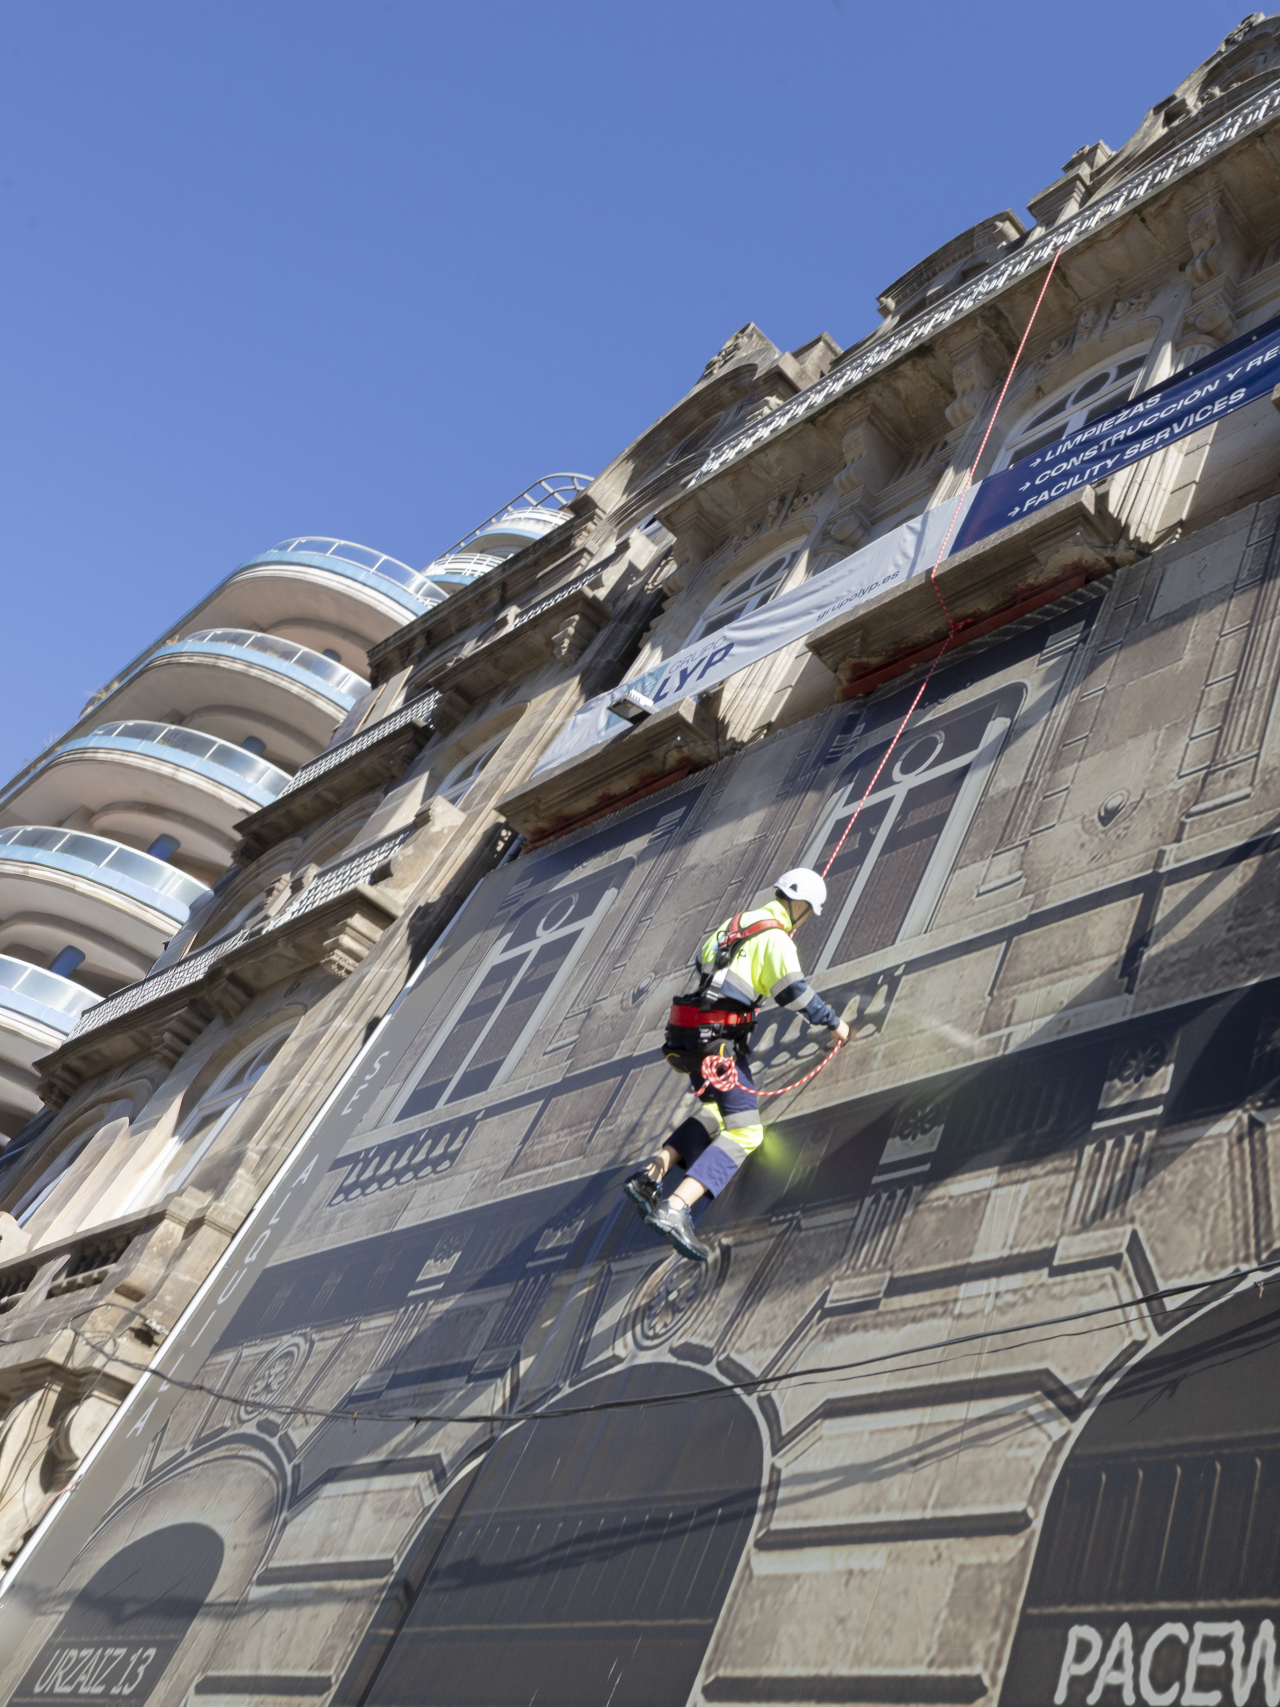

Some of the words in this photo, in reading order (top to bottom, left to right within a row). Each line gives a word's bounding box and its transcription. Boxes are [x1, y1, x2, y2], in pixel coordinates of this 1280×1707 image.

[1022, 453, 1121, 512] FACILITY
[1123, 387, 1247, 460] SERVICES
[1034, 379, 1220, 485] CONSTRUCCIÓN
[1226, 366, 1242, 382] Y
[1044, 393, 1161, 462] LIMPIEZAS
[816, 570, 900, 622] grupolyp.es
[652, 642, 735, 704] LYP
[668, 635, 727, 675] GRUPO
[340, 1050, 390, 1117] SE
[126, 1153, 320, 1439] ALQUILA
[33, 1647, 128, 1695] URZAIZ
[109, 1646, 157, 1696] 13
